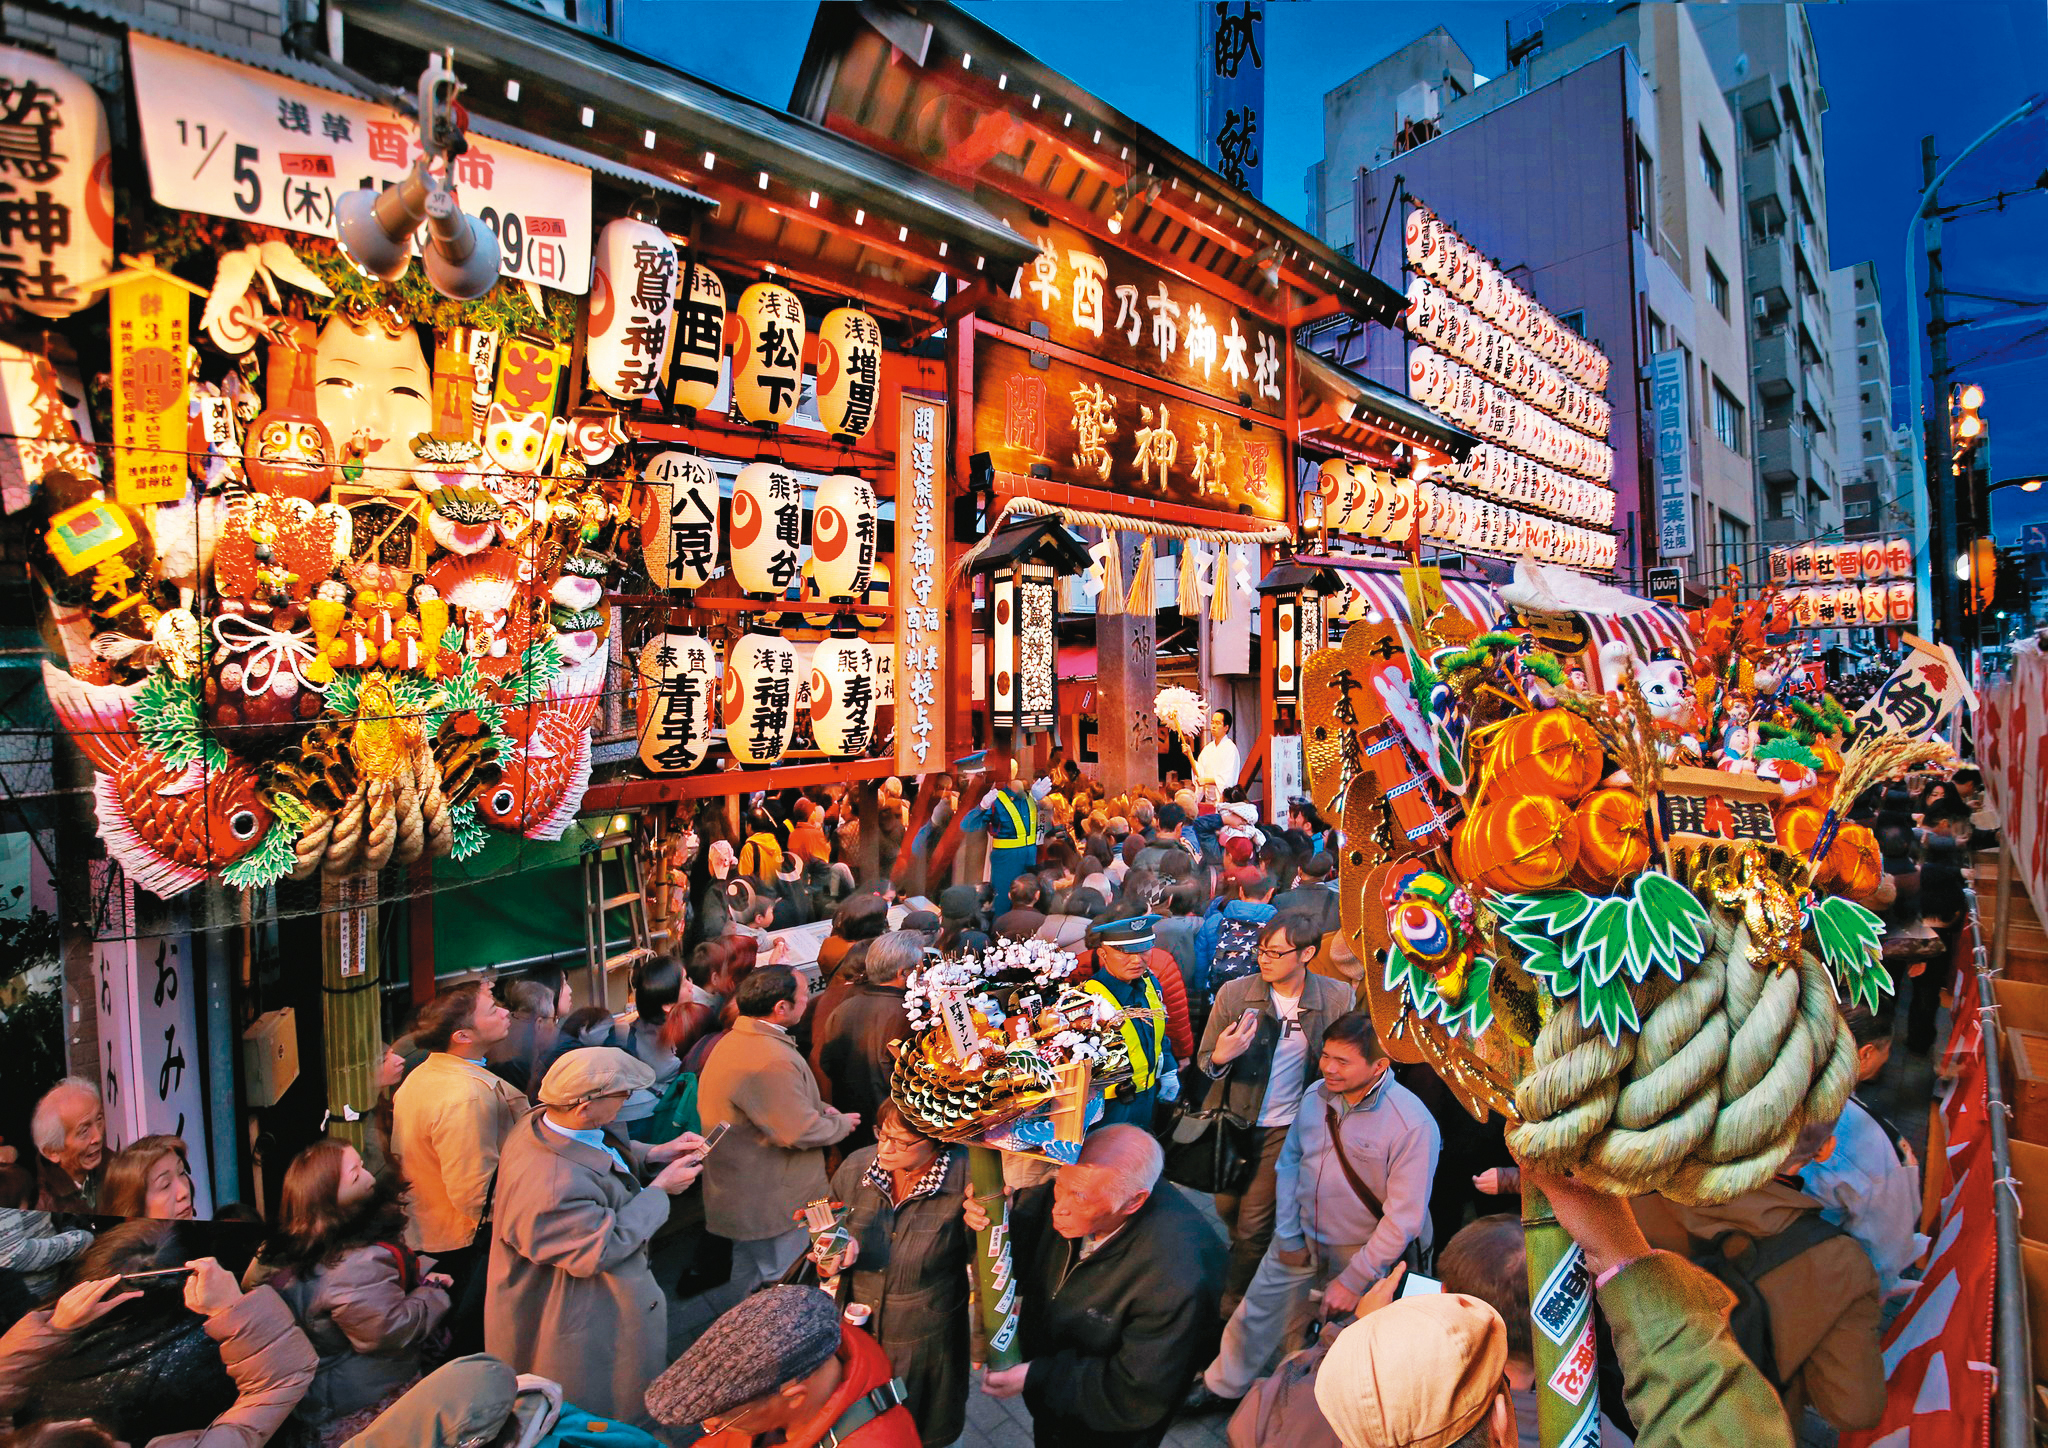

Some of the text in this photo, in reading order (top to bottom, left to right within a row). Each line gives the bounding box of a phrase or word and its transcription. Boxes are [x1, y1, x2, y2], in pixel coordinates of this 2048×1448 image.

[278, 97, 495, 190] 浅草 酉市
[615, 240, 674, 395] 鷲神社
[759, 291, 801, 324] 浅草
[844, 316, 880, 347] 浅草
[1010, 235, 1281, 401] 草酉乃市御本社
[757, 320, 800, 416] 松下
[1070, 381, 1230, 497] 鷲神社
[1657, 357, 1685, 523] 三和自動車工業
[666, 487, 716, 582] 八百代
[767, 503, 800, 587] 亀谷
[910, 407, 936, 606] 開運熊手御守
[753, 648, 794, 675] 浅草
[838, 647, 873, 673] 熊手
[653, 673, 701, 770] 青年会
[749, 677, 790, 760] 福神講
[910, 671, 936, 765] 授与す
